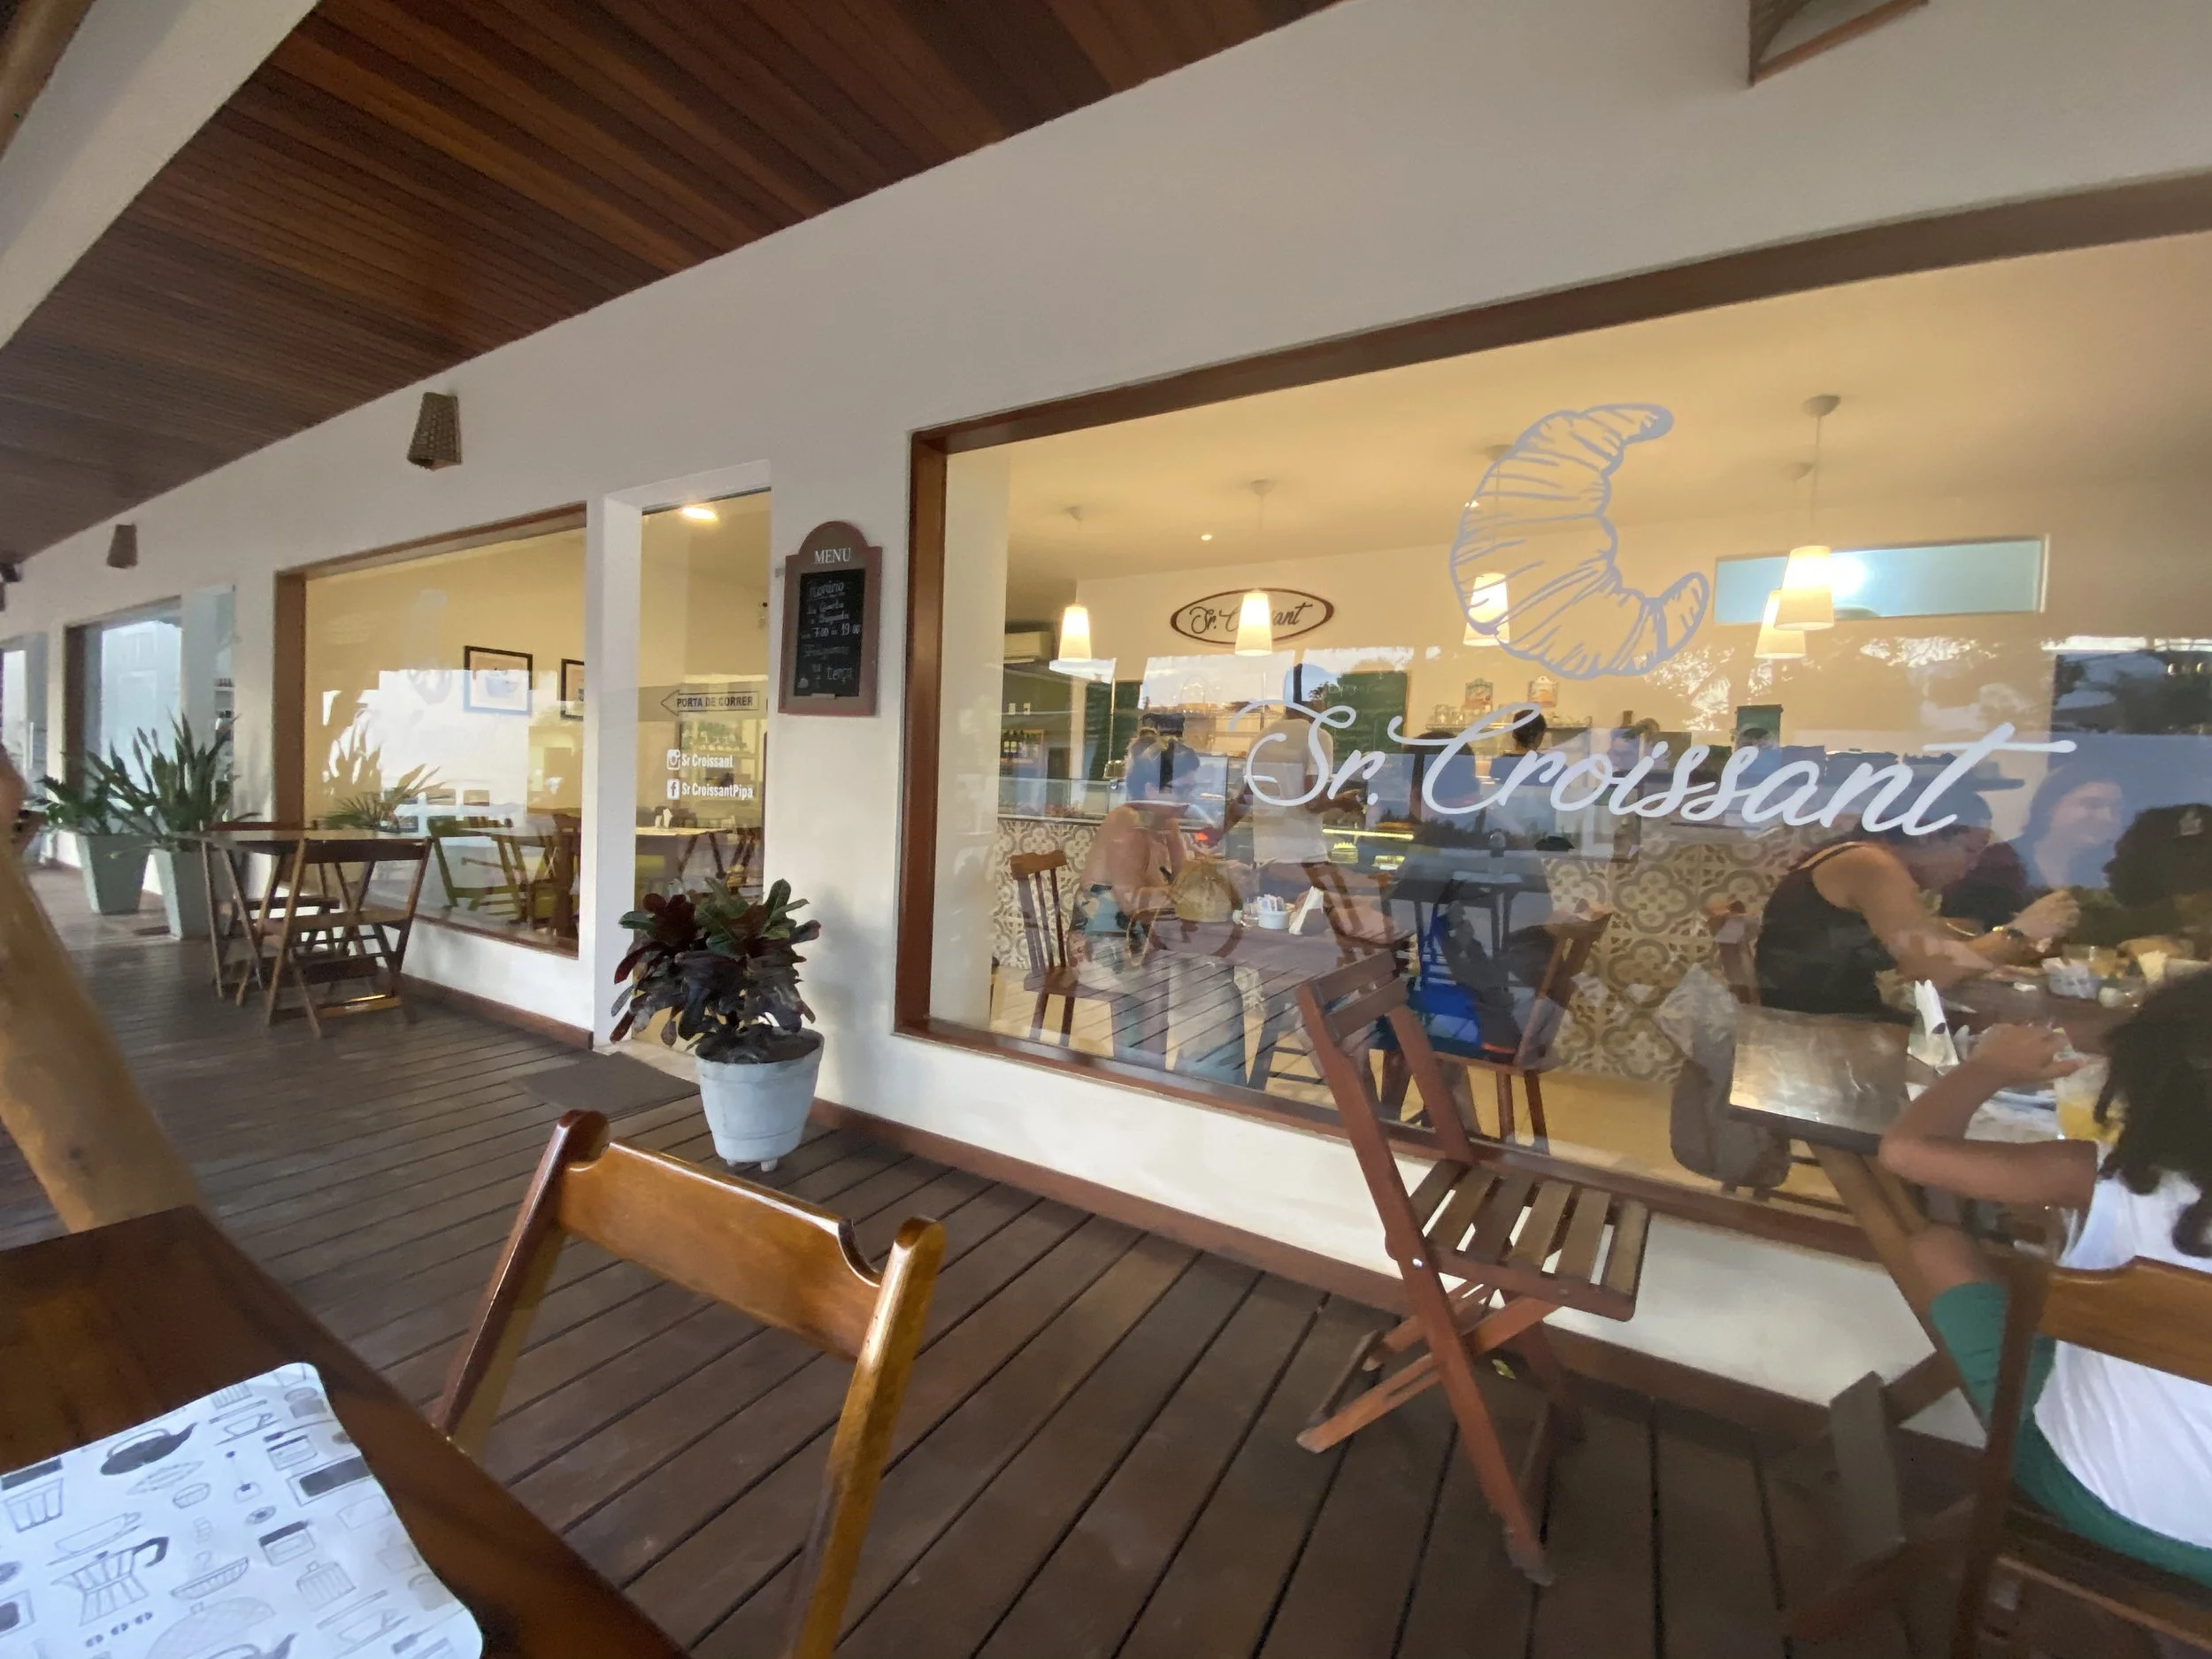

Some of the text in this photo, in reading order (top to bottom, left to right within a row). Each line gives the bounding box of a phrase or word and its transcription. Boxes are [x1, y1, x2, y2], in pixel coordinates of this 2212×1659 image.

[814, 548, 851, 565] MENU
[1189, 606, 1217, 634] Sr.
[677, 696, 753, 708] PORTA DE CORRER
[681, 753, 733, 768] Sr Croissant
[1228, 697, 1380, 809] Sr.
[1387, 701, 2078, 837] Croissant
[681, 783, 754, 800] Sr CroissantPipa
